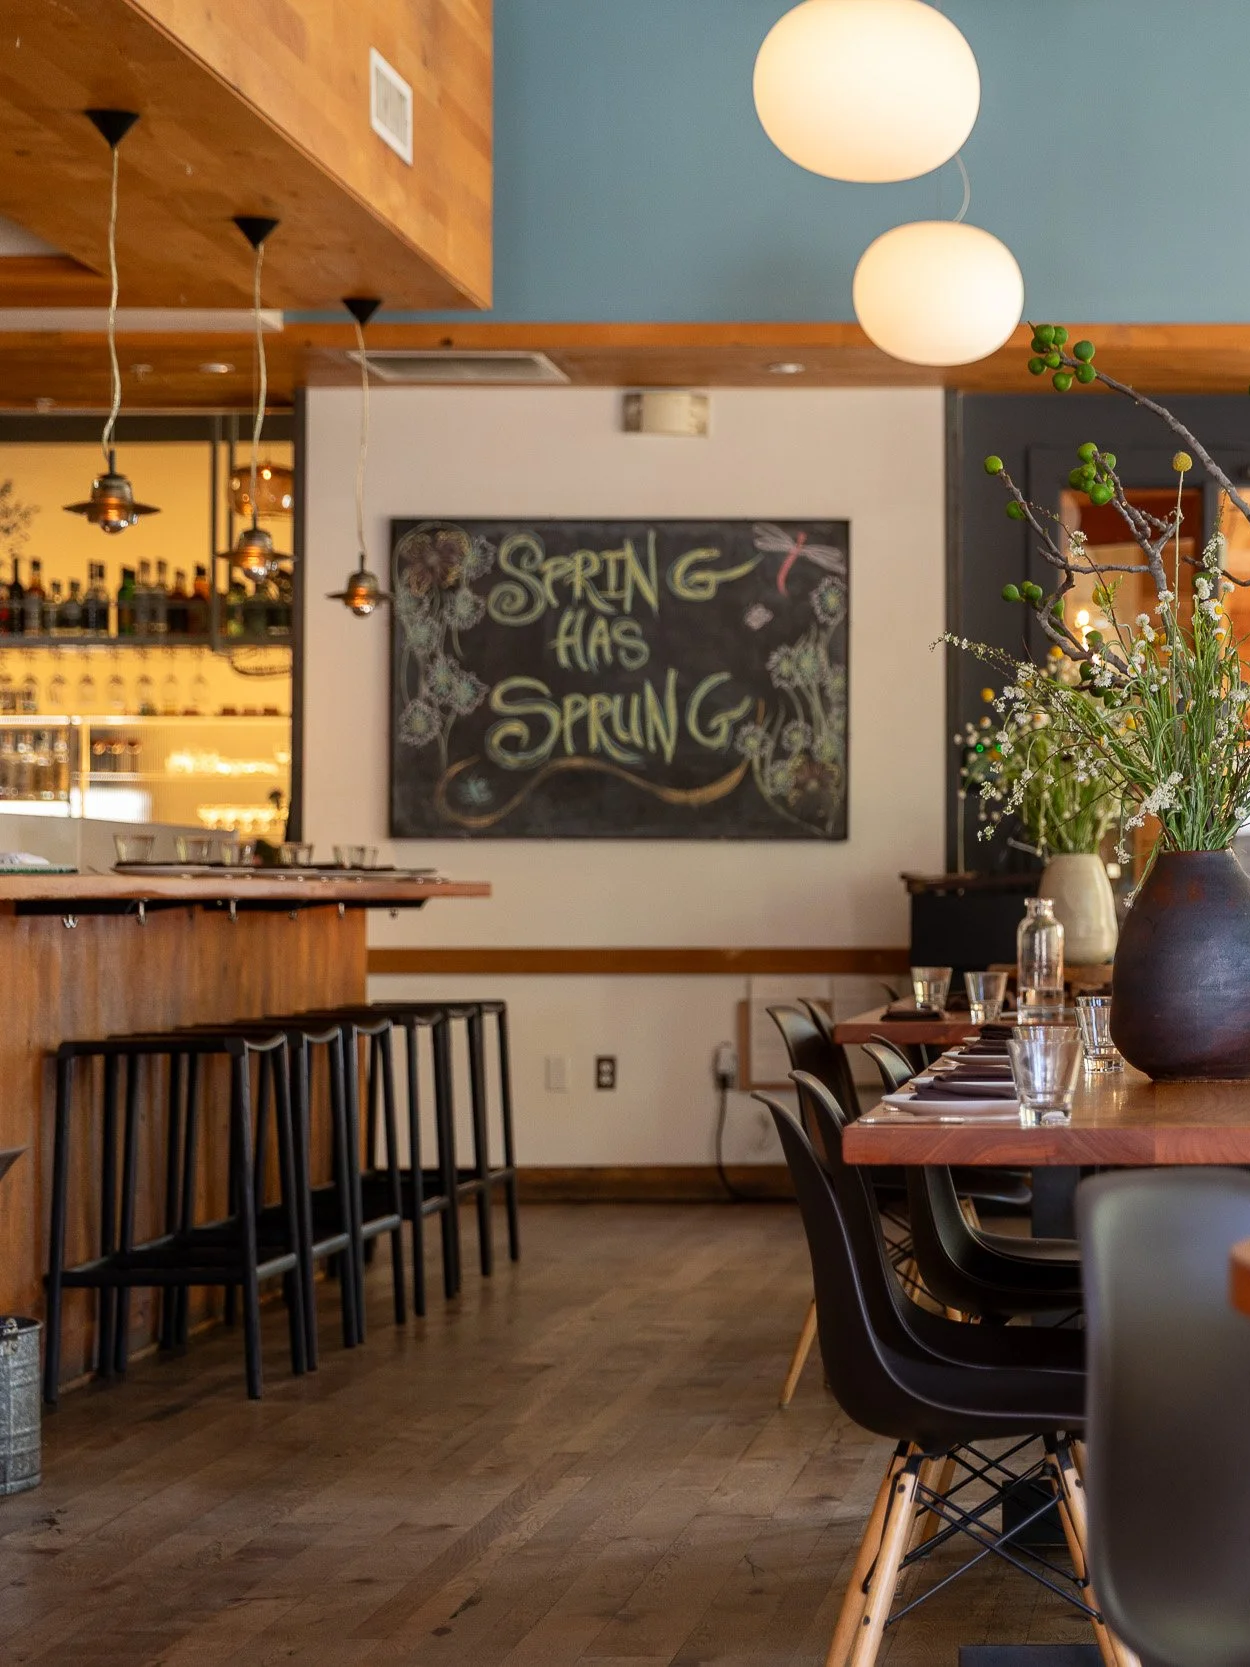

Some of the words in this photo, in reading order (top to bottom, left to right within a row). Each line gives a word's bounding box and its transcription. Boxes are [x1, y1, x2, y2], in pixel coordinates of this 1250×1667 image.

[488, 530, 764, 626] SPRING
[549, 606, 650, 672] HAS
[485, 668, 752, 770] SPRUNG
